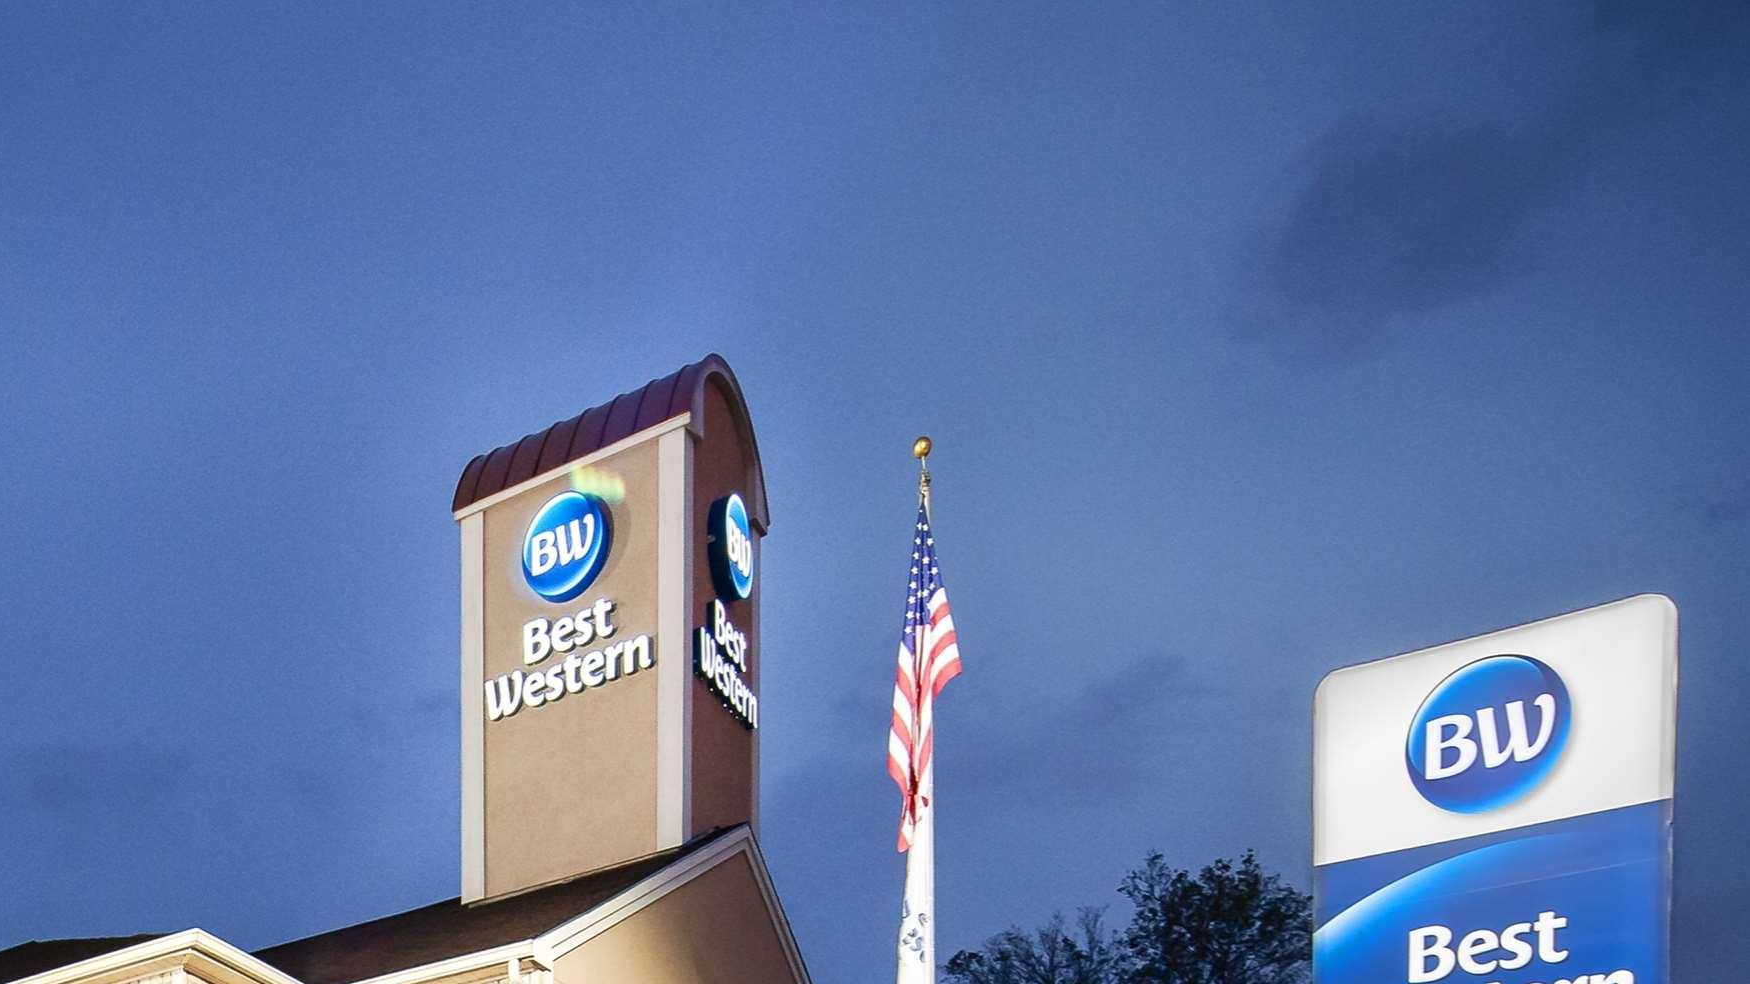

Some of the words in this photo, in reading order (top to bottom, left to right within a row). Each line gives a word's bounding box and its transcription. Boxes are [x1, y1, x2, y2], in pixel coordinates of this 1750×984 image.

[531, 513, 595, 577] BW
[727, 517, 753, 578] BW
[522, 598, 617, 665] Best
[713, 599, 748, 673] Best
[484, 634, 655, 721] Western
[700, 626, 758, 729] Western
[1424, 693, 1557, 780] BW
[1407, 910, 1570, 984] Best
